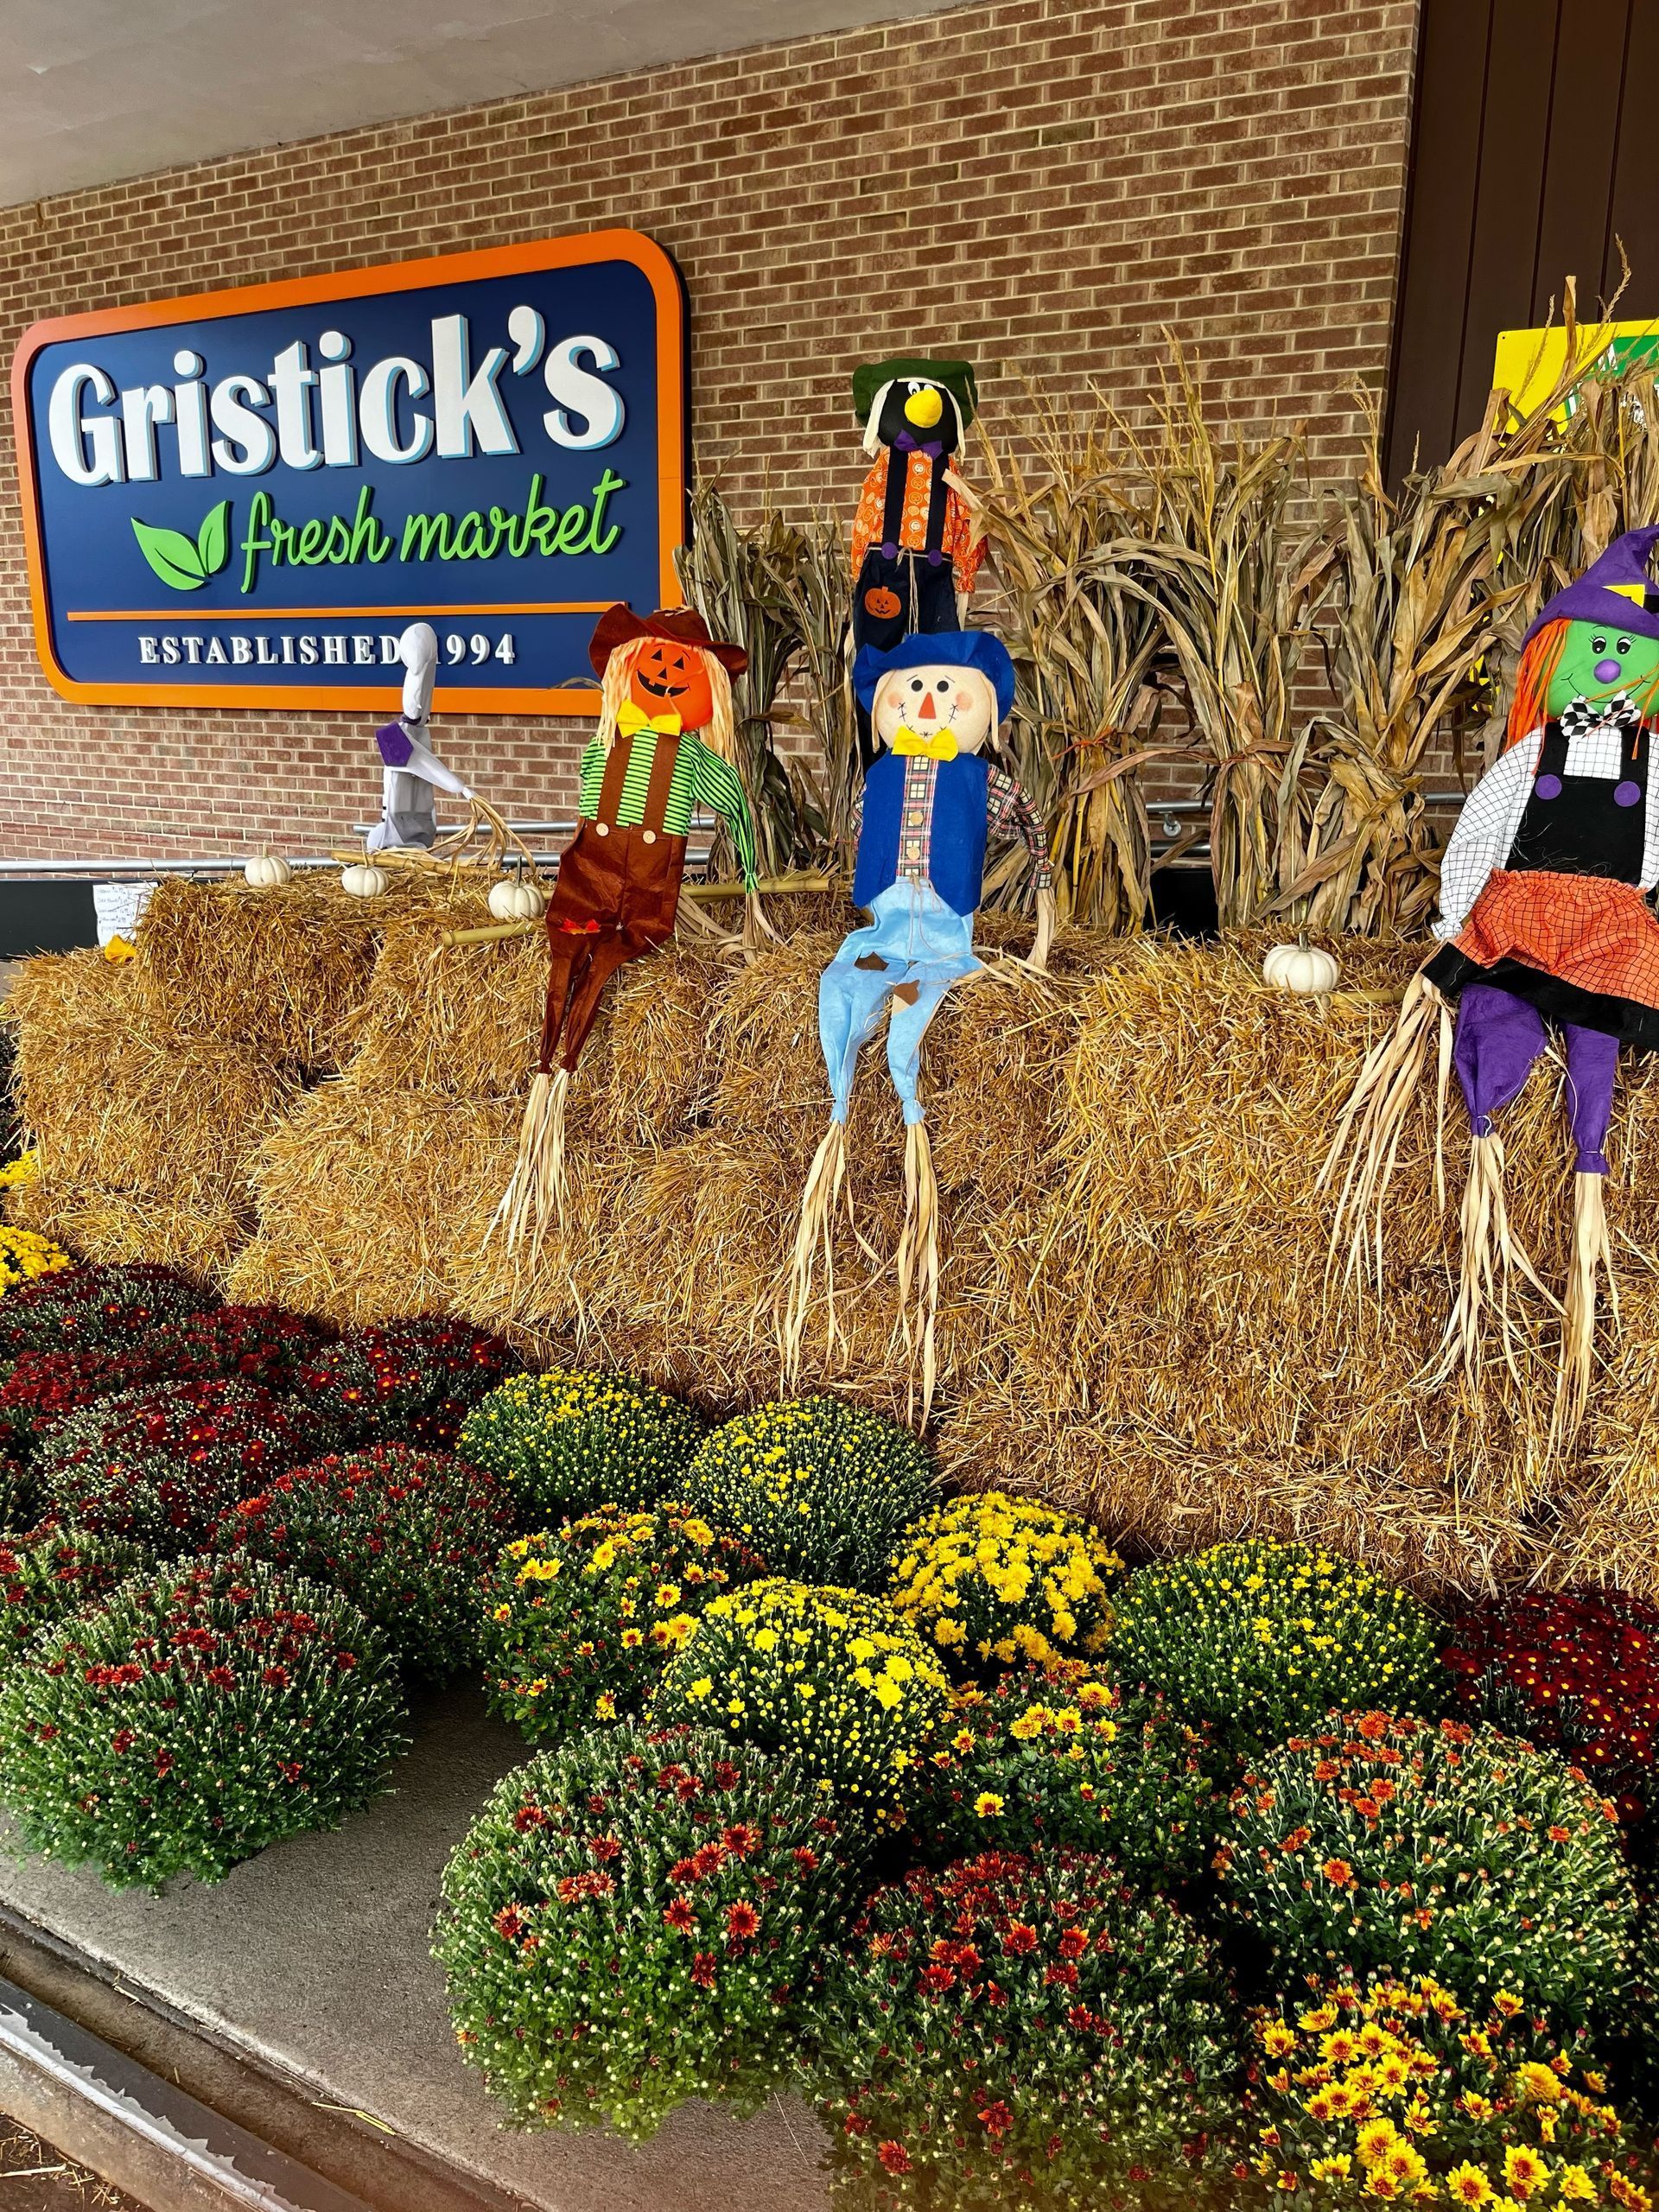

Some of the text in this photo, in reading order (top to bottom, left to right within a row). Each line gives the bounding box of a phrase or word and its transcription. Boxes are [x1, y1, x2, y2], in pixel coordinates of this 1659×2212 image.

[240, 468, 626, 594] fresh market
[138, 633, 516, 665] ESTABLISHED 994
